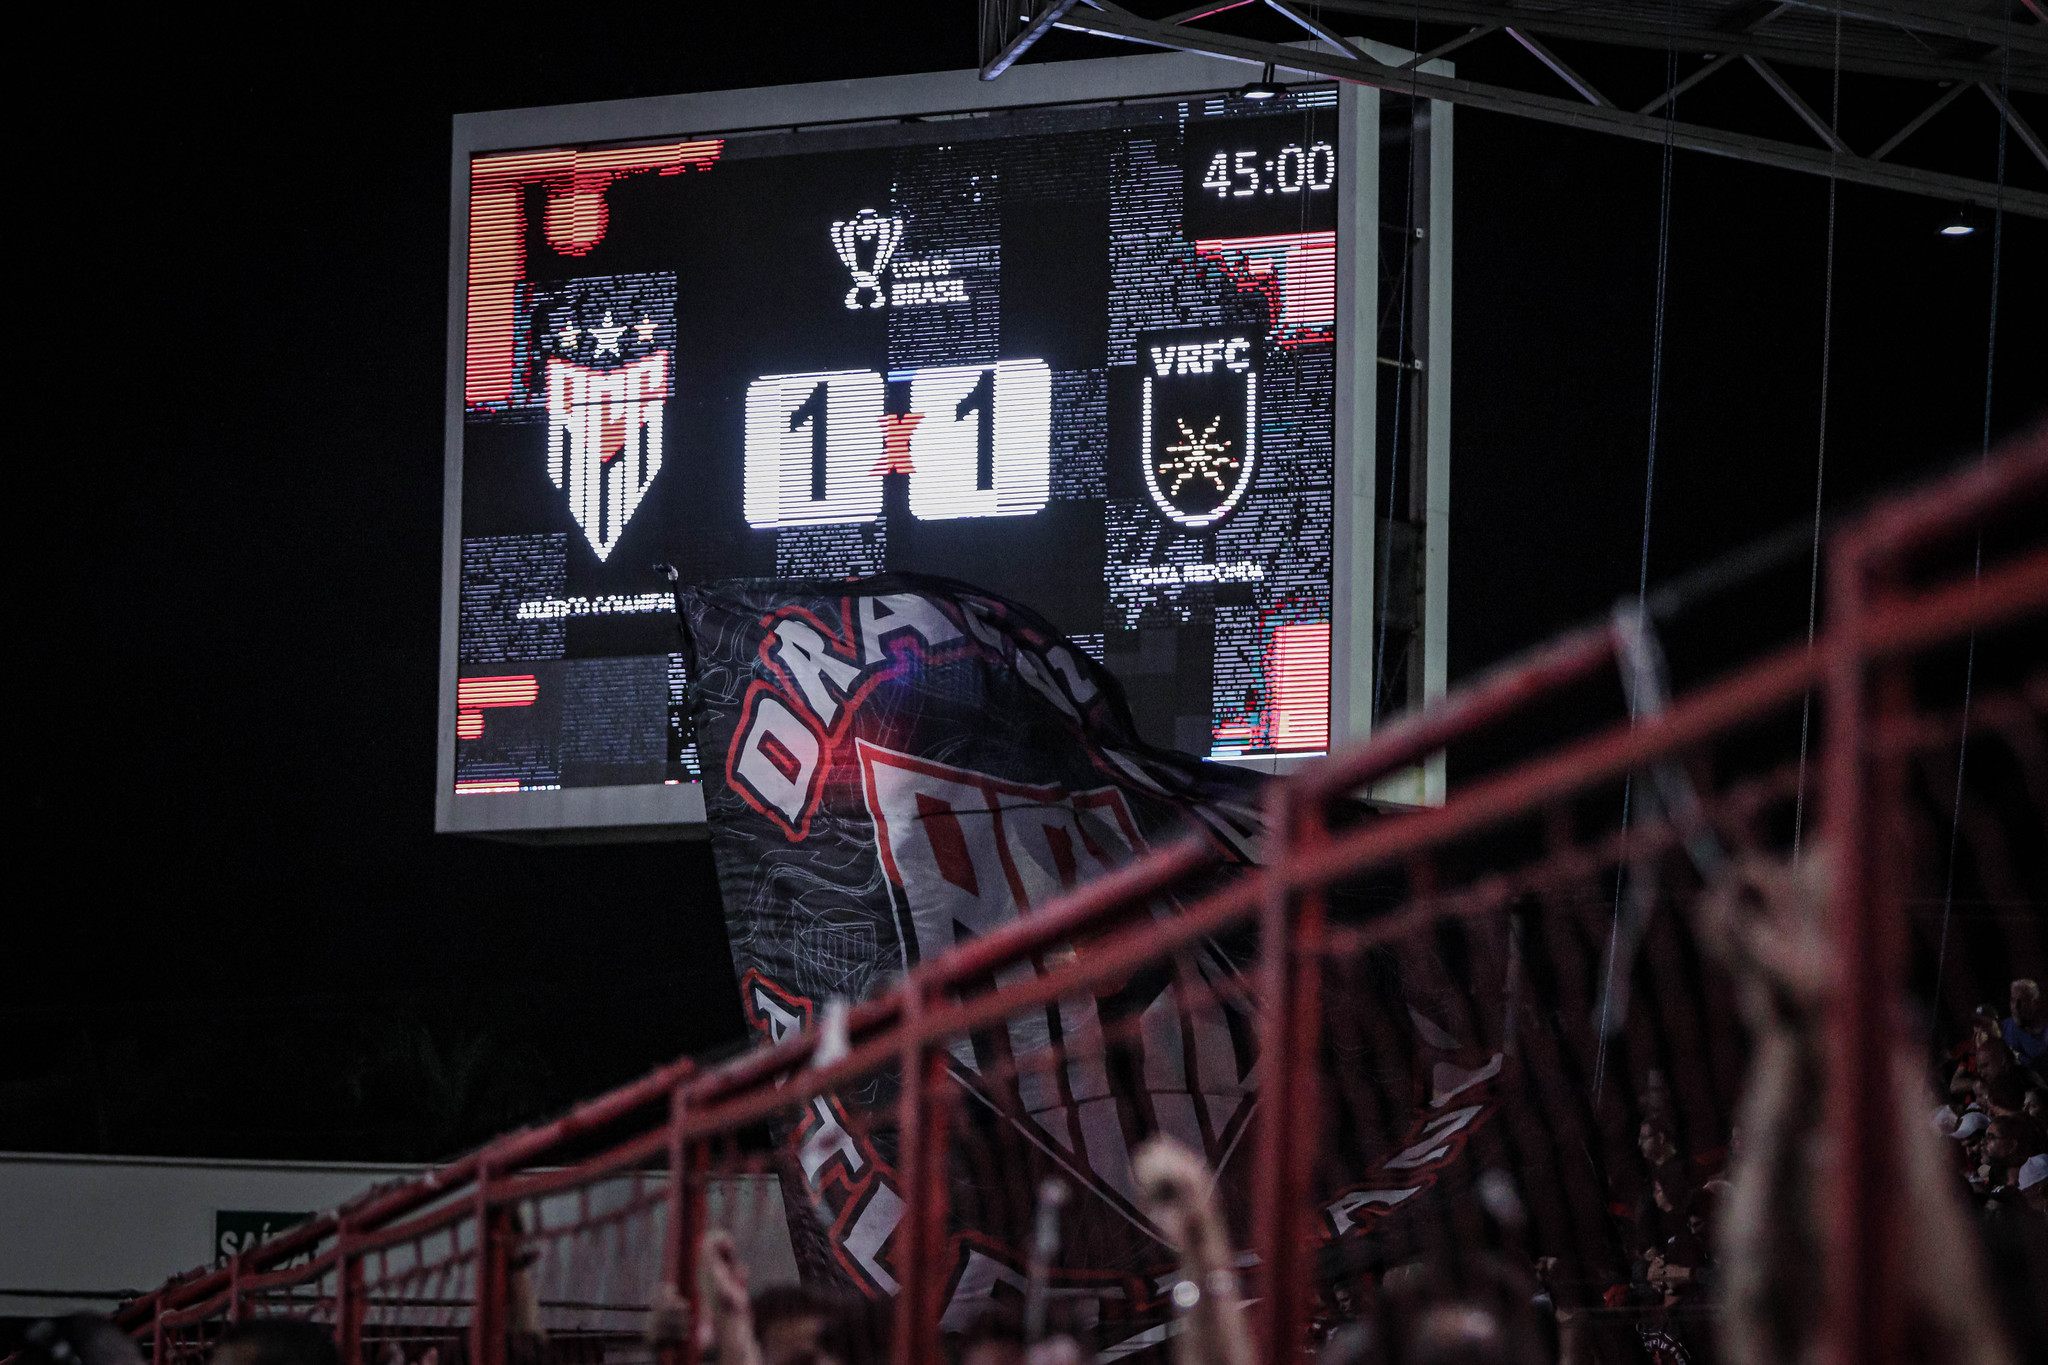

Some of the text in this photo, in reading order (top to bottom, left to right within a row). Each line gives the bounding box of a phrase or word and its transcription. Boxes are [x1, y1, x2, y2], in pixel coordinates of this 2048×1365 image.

[1201, 140, 1335, 198] 45:00
[892, 279, 970, 306] BRASIL
[1151, 337, 1251, 376] VRFC
[789, 381, 828, 499] 1
[955, 370, 996, 490] 1
